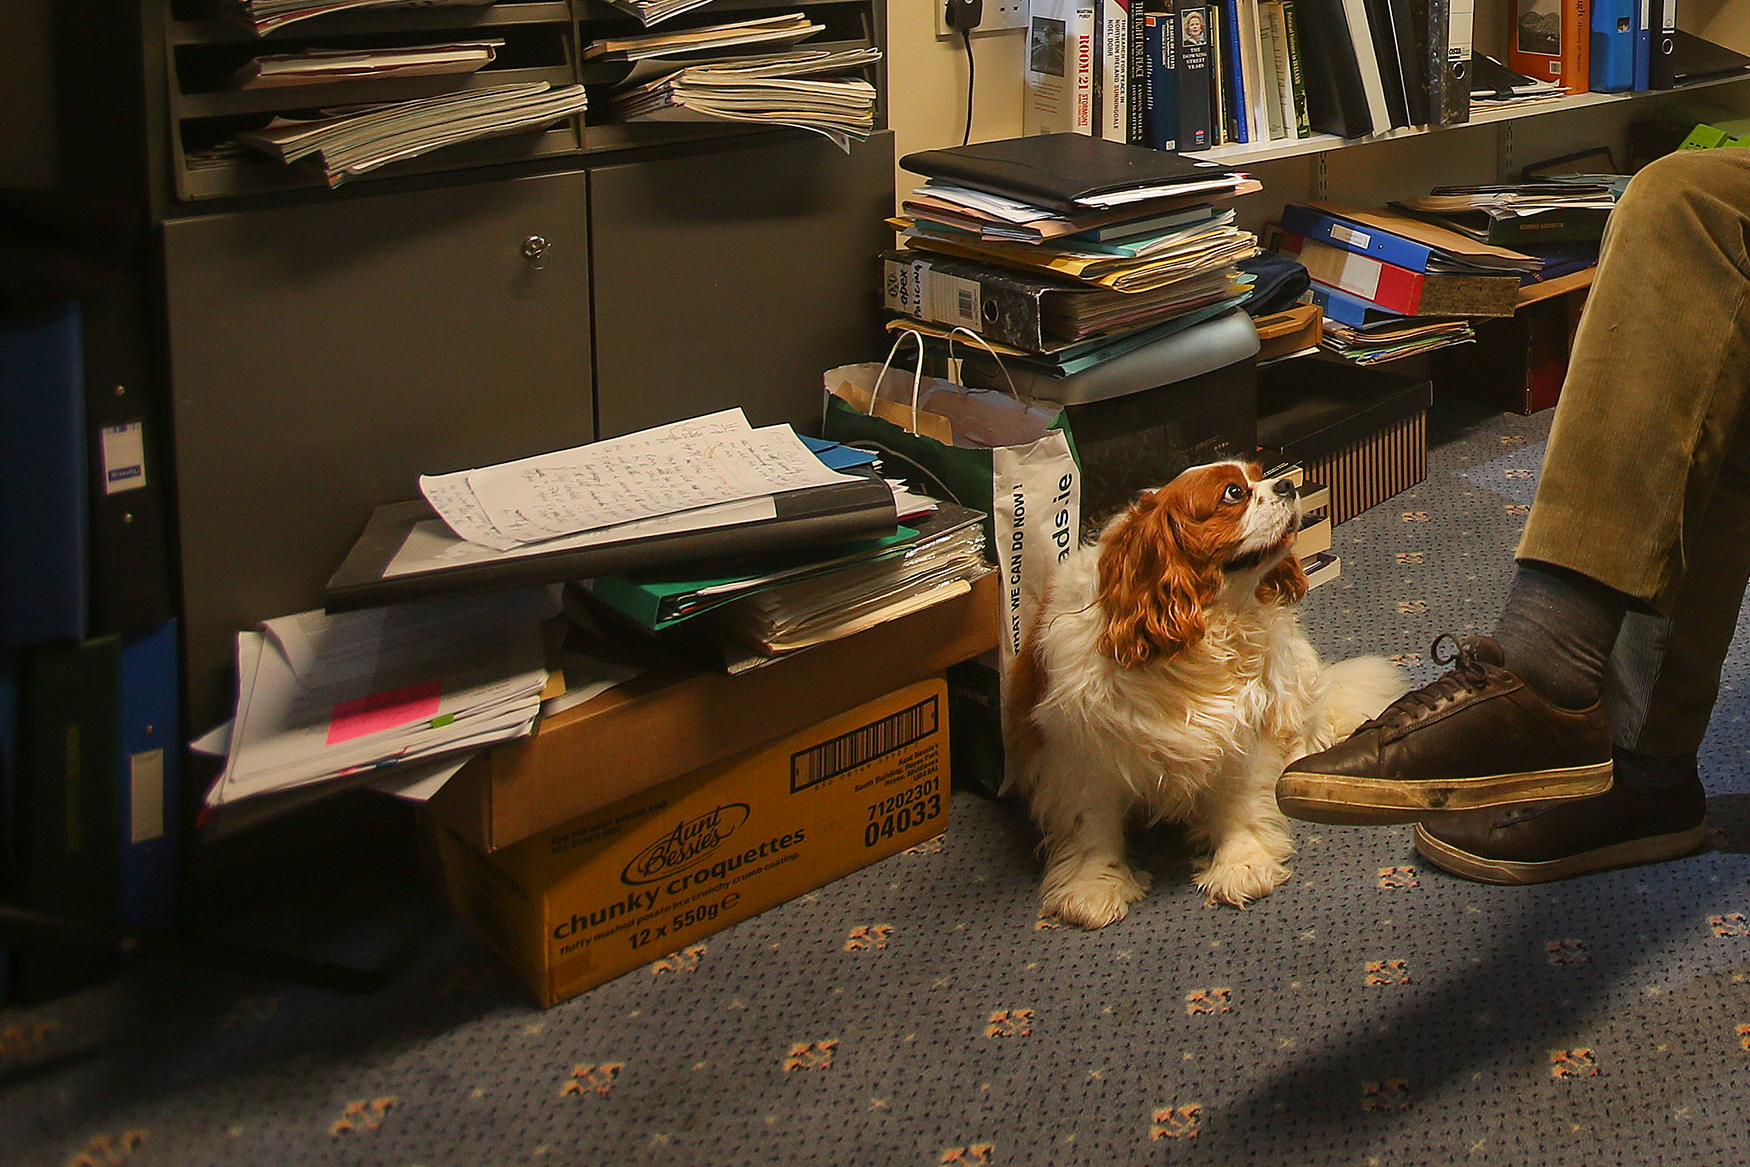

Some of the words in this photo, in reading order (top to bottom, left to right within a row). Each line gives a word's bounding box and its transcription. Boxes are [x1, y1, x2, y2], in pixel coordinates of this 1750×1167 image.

[1135, 2, 1143, 17] THE
[1135, 18, 1143, 41] FIGHT
[1079, 35, 1090, 74] ROOM
[1135, 42, 1143, 56] FOR
[1135, 57, 1143, 78] PEACE
[1079, 77, 1089, 89] 21
[900, 268, 908, 312] apex
[1013, 492, 1024, 528] NOW
[1012, 531, 1023, 552] DO
[1010, 554, 1022, 585] CAN
[1011, 586, 1020, 611] WE
[1012, 615, 1020, 656] WHAT
[854, 781, 873, 792] South
[925, 750, 939, 762] Park
[899, 754, 913, 765] Aunt
[907, 759, 939, 777] Middlesex
[868, 776, 939, 821] 71202301
[666, 805, 722, 851] Aunt
[864, 794, 941, 847] 04033
[638, 829, 722, 876] Bessie's
[554, 882, 660, 940] chunky
[666, 828, 806, 897] croquettes
[560, 934, 592, 955] fluffy
[593, 922, 635, 942] mashed
[636, 906, 671, 929] potato
[692, 880, 731, 905] crunchy
[731, 866, 764, 888] crumb
[764, 851, 800, 876] coating.
[628, 931, 649, 951] 12
[652, 924, 668, 939] x
[672, 904, 719, 934] 550g
